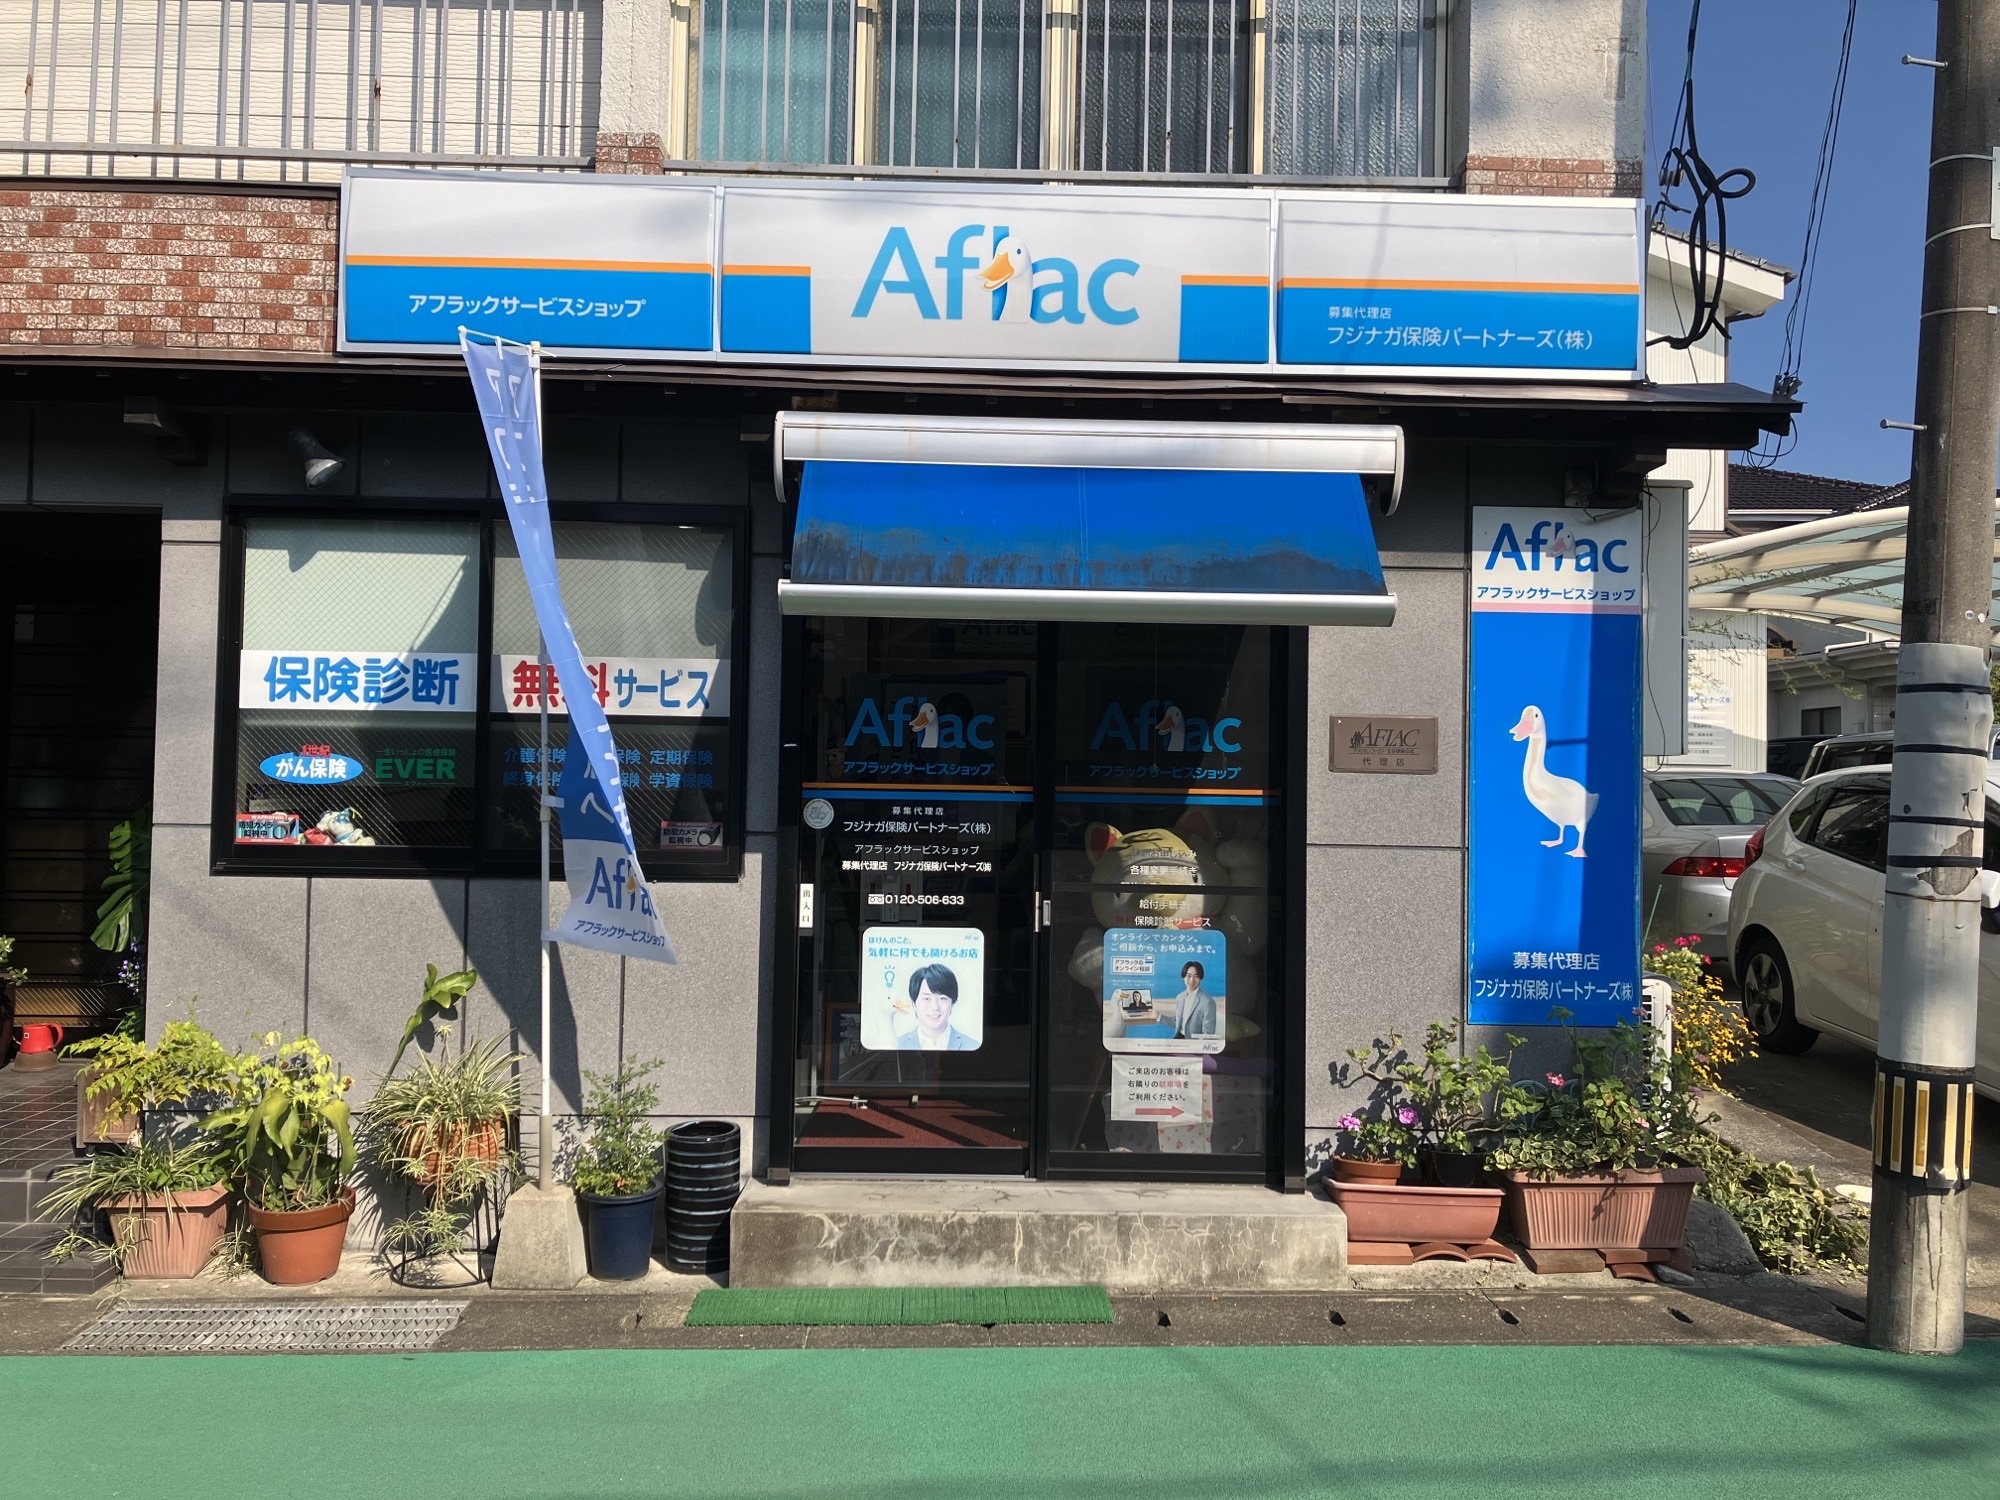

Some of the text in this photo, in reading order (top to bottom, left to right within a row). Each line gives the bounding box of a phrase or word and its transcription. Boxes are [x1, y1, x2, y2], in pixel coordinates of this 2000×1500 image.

[408, 293, 647, 319] アフラックサービスショップ
[1328, 306, 1392, 320] 募集代理店
[1327, 326, 1593, 350] フジナガ保険パートナーズ(株)
[1477, 586, 1636, 601] アフラックサービスショップ
[263, 655, 460, 706] 保険診断
[1358, 722, 1420, 747] AFLAC
[650, 750, 713, 766] 定期保険
[275, 758, 347, 779] がん保険
[375, 758, 456, 780] EVER
[843, 761, 995, 776] アフラックサービスショップ
[1089, 765, 1242, 780] アフラックサービスショップ
[649, 773, 713, 789] 学資保険
[892, 806, 944, 816] 募集代理店
[238, 821, 274, 829] 防犯カメラ
[663, 828, 698, 836] 防犯カメラ
[843, 821, 991, 835] フジナガ保険パートナーズ(株)
[243, 829, 268, 838] 監視中
[668, 836, 692, 844] 監視中
[855, 844, 979, 855] アフラックサービスショップ
[842, 861, 888, 870] 募集代理店
[802, 889, 811, 922] 出入口
[885, 894, 965, 905] 0120-506-633
[1111, 933, 1198, 943] オンラインでカンタン。
[868, 947, 978, 959] 気軽に何でも聞けるお店
[1110, 943, 1216, 954] ご相談から、お申込みまで。
[1513, 951, 1600, 971] 募集代理店
[1128, 1067, 1190, 1075] ご来店のお客様は
[1128, 1080, 1189, 1089] 右隣りの駐車場を
[1128, 1093, 1187, 1101] ご利用ください。
